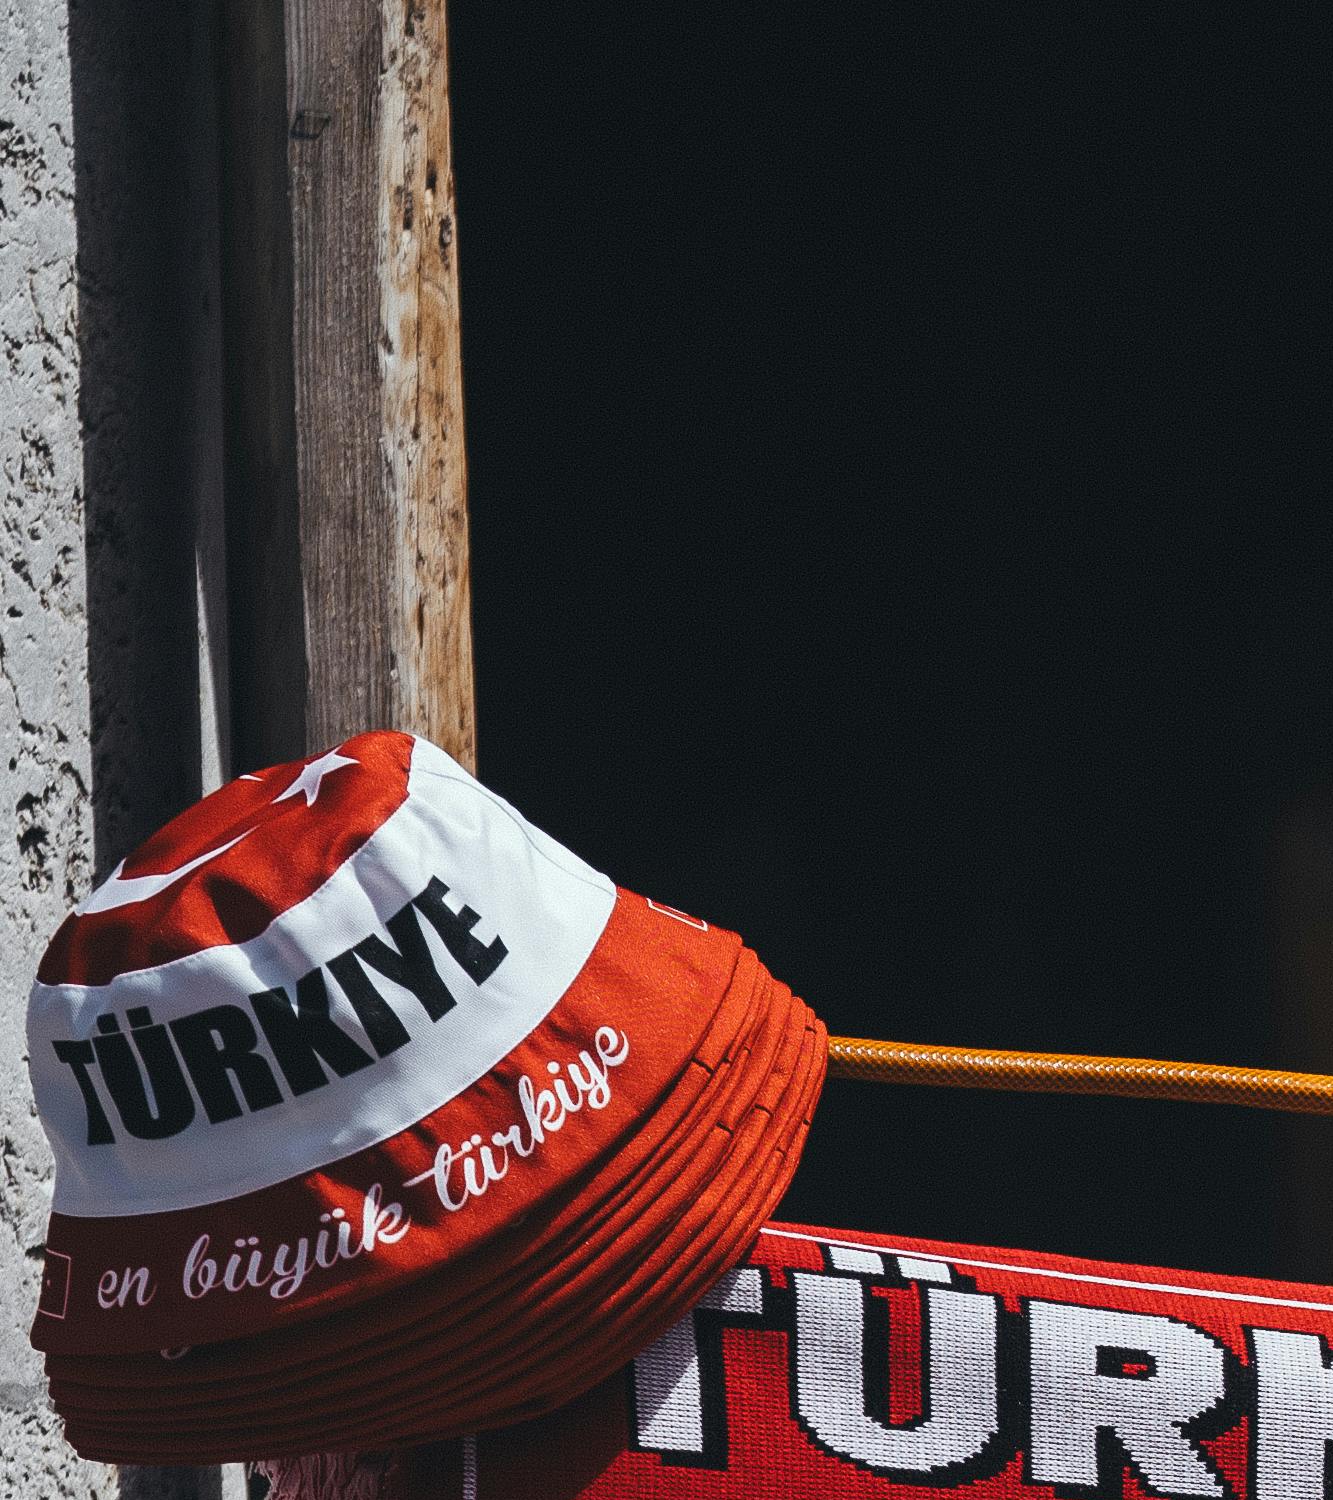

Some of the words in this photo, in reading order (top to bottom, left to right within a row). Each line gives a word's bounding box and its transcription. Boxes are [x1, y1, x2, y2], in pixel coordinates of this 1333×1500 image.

[53, 876, 508, 1145] TÜRKIYE
[98, 1264, 156, 1309] en
[183, 1184, 411, 1301] büyük
[403, 1025, 629, 1212] türkiye
